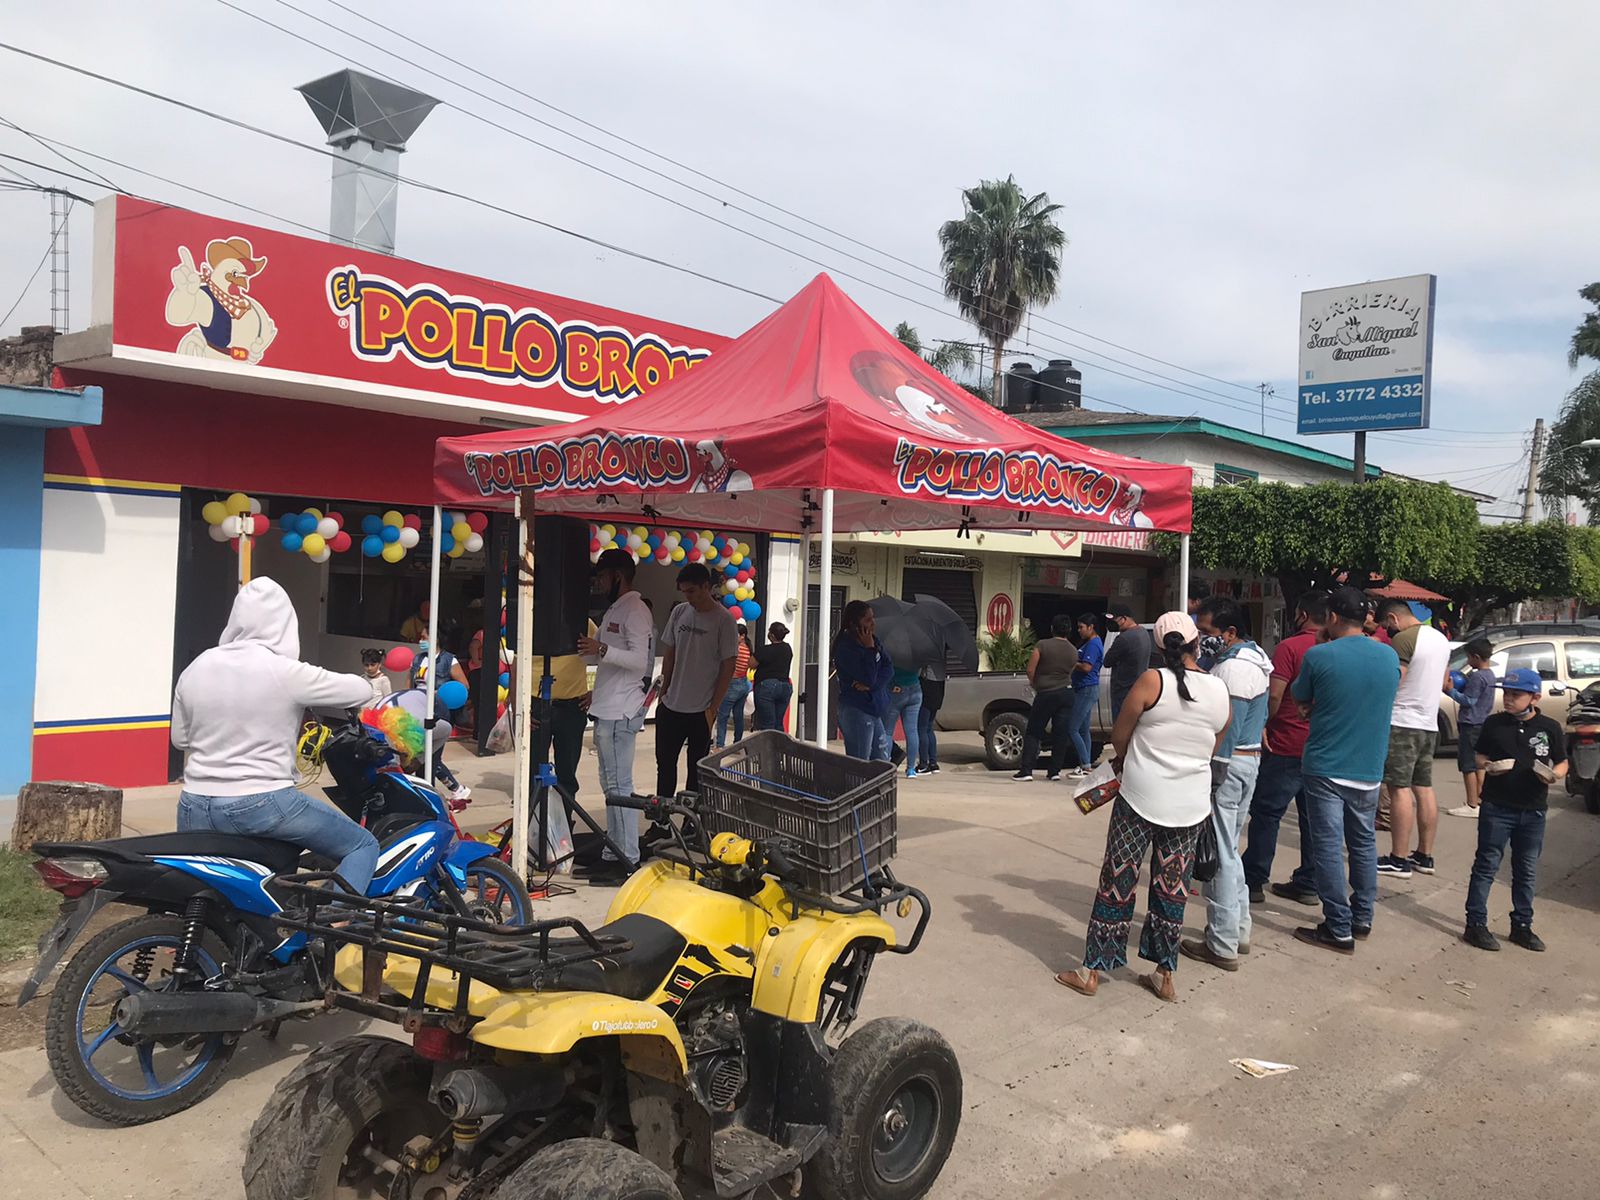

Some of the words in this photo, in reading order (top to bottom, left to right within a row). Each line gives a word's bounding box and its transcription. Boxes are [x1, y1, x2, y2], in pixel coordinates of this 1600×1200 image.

[332, 273, 362, 310] El
[359, 286, 557, 378] POLLO
[1307, 333, 1339, 349] San
[1360, 320, 1419, 344] Miguel
[1302, 391, 1331, 405] Tel.
[1335, 387, 1376, 403] 3772
[1380, 382, 1422, 399] 4332
[473, 446, 563, 490] POLLO
[562, 436, 688, 482] BRONCO
[903, 446, 1001, 492] POLLO
[1003, 457, 1116, 509] BRONCO
